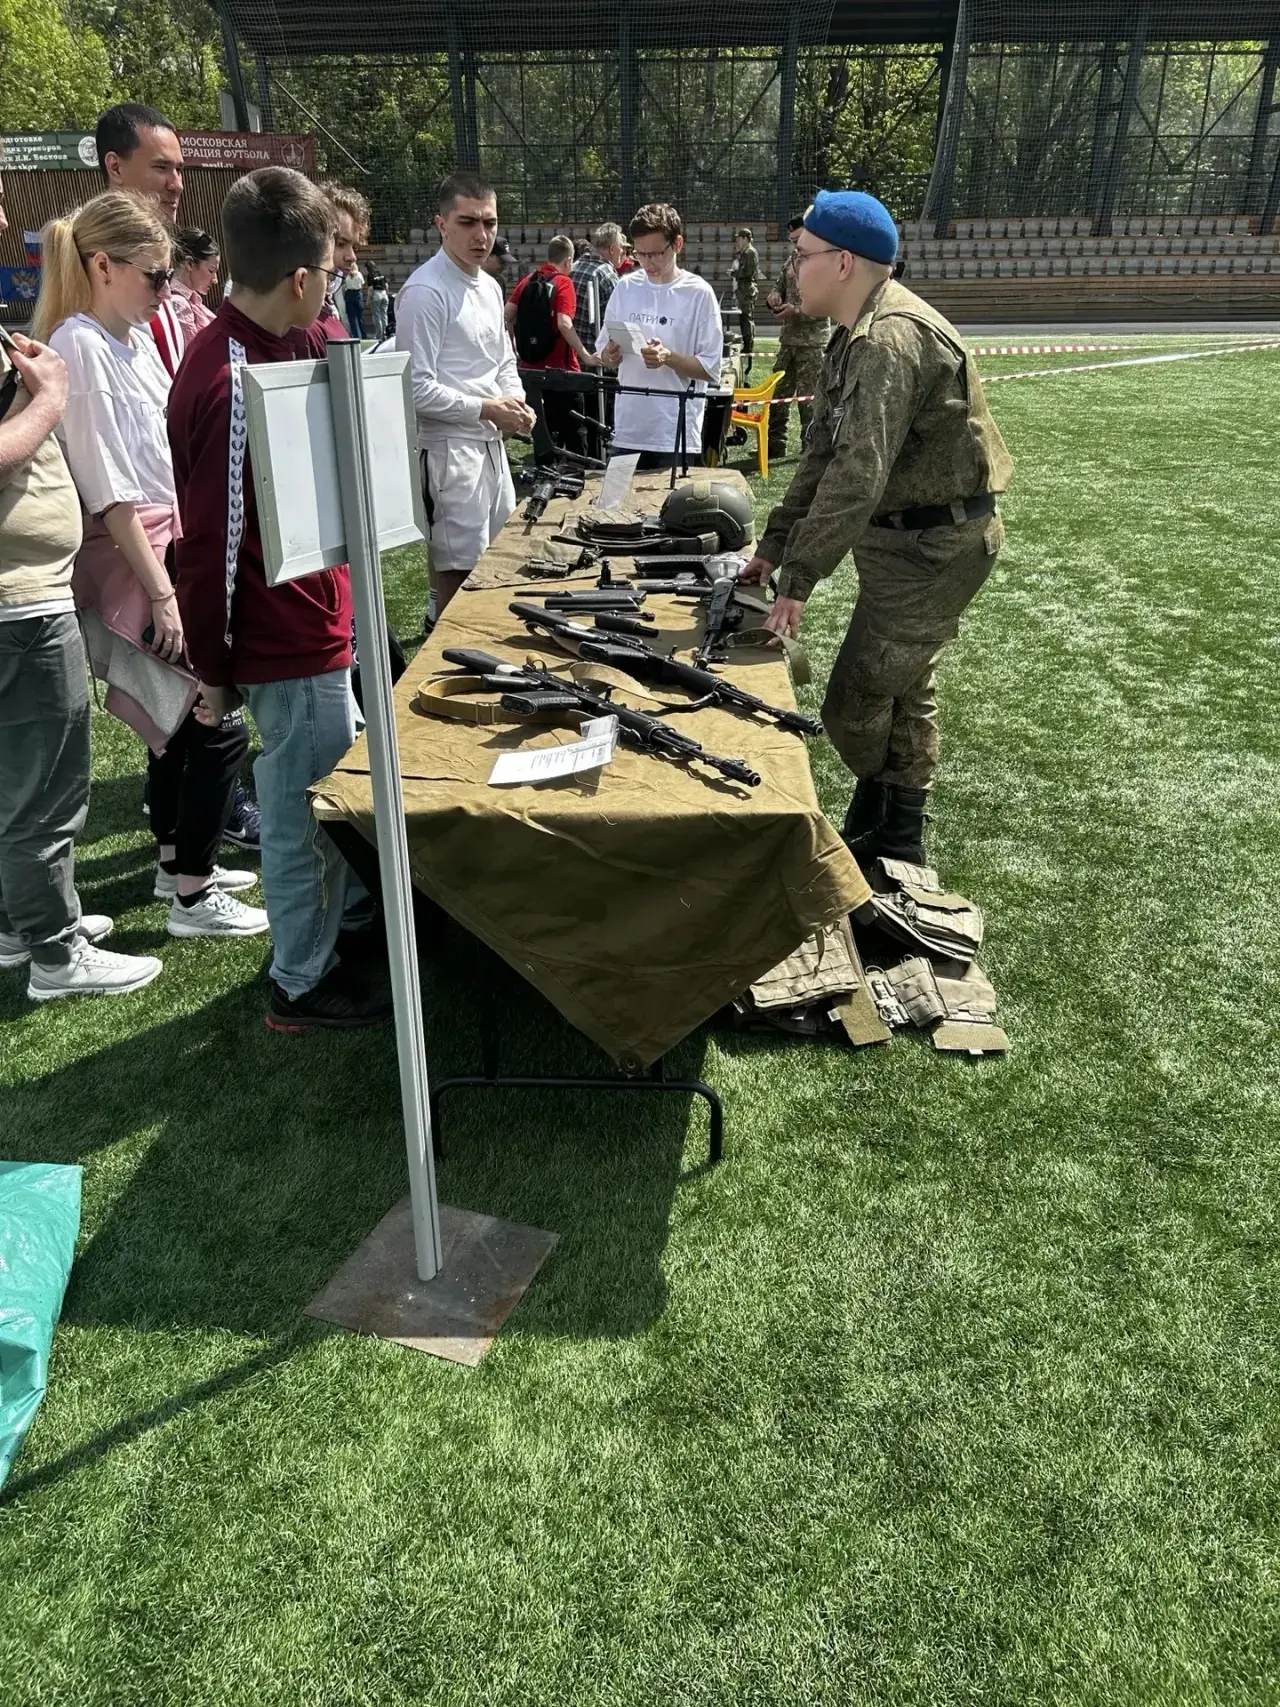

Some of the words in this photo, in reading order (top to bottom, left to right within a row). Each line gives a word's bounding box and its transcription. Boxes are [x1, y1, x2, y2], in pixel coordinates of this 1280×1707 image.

[180, 136, 248, 149] МОСКОВСКАЯ
[182, 147, 221, 159] ЕРАЦИЯ
[223, 149, 271, 161] ФУТБОЛА
